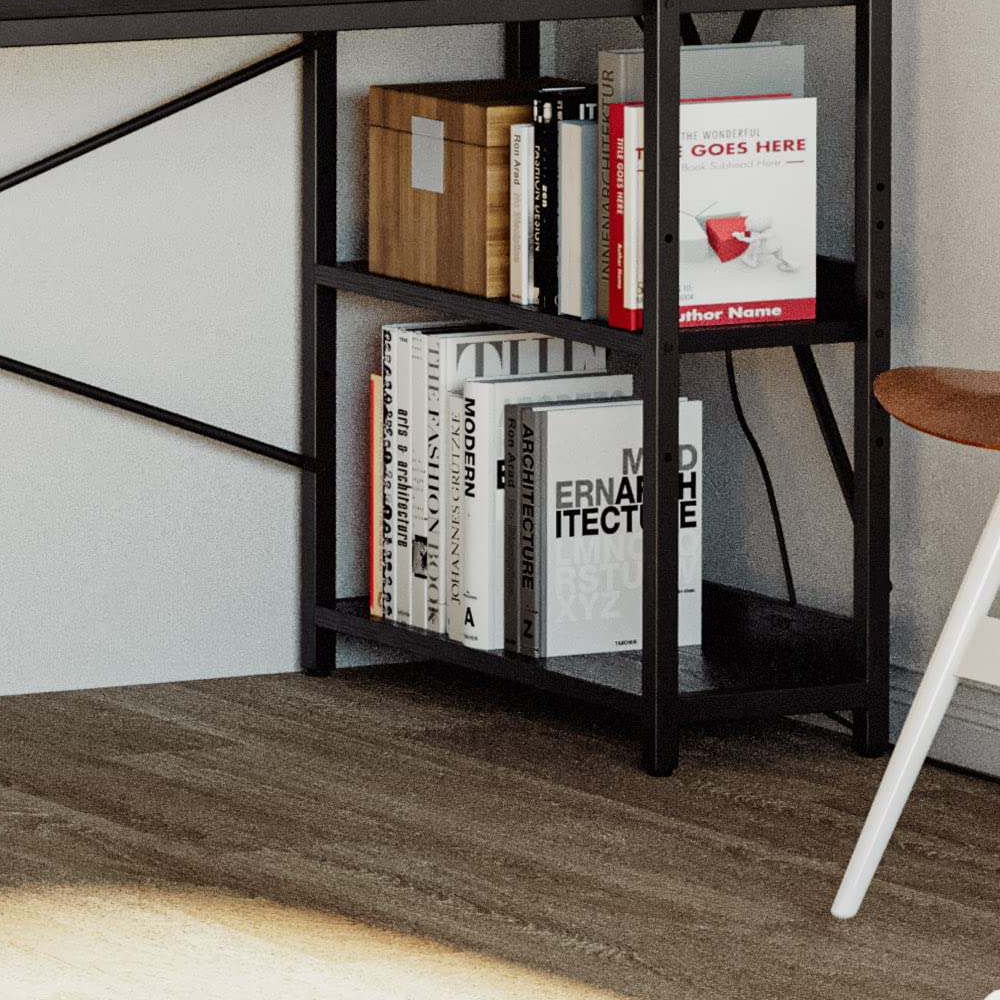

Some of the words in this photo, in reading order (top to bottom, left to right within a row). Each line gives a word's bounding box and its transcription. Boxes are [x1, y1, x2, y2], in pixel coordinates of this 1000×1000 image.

[513, 134, 521, 157] Ron
[616, 137, 624, 160] TITLE
[681, 131, 698, 141] THE
[703, 128, 760, 140] WONDERFUL
[691, 141, 748, 157] GOES
[756, 139, 806, 153] HERE
[513, 158, 521, 186] Arad
[616, 162, 624, 189] GOES
[616, 191, 624, 215] HERE
[679, 309, 722, 323] uthor
[728, 306, 782, 319] Name
[427, 342, 440, 401] THE
[397, 408, 410, 438] arts
[507, 417, 517, 448] Ron
[464, 397, 476, 499] MODERN
[623, 444, 698, 475] MD
[427, 409, 440, 534] FASHION
[507, 451, 517, 489] Arad
[396, 461, 411, 548] architecture
[556, 472, 697, 509] ERNAH
[522, 423, 535, 590] ARCHITECTURE
[556, 500, 697, 538] ITECTE
[427, 543, 440, 625] BOOK
[464, 606, 475, 627] A
